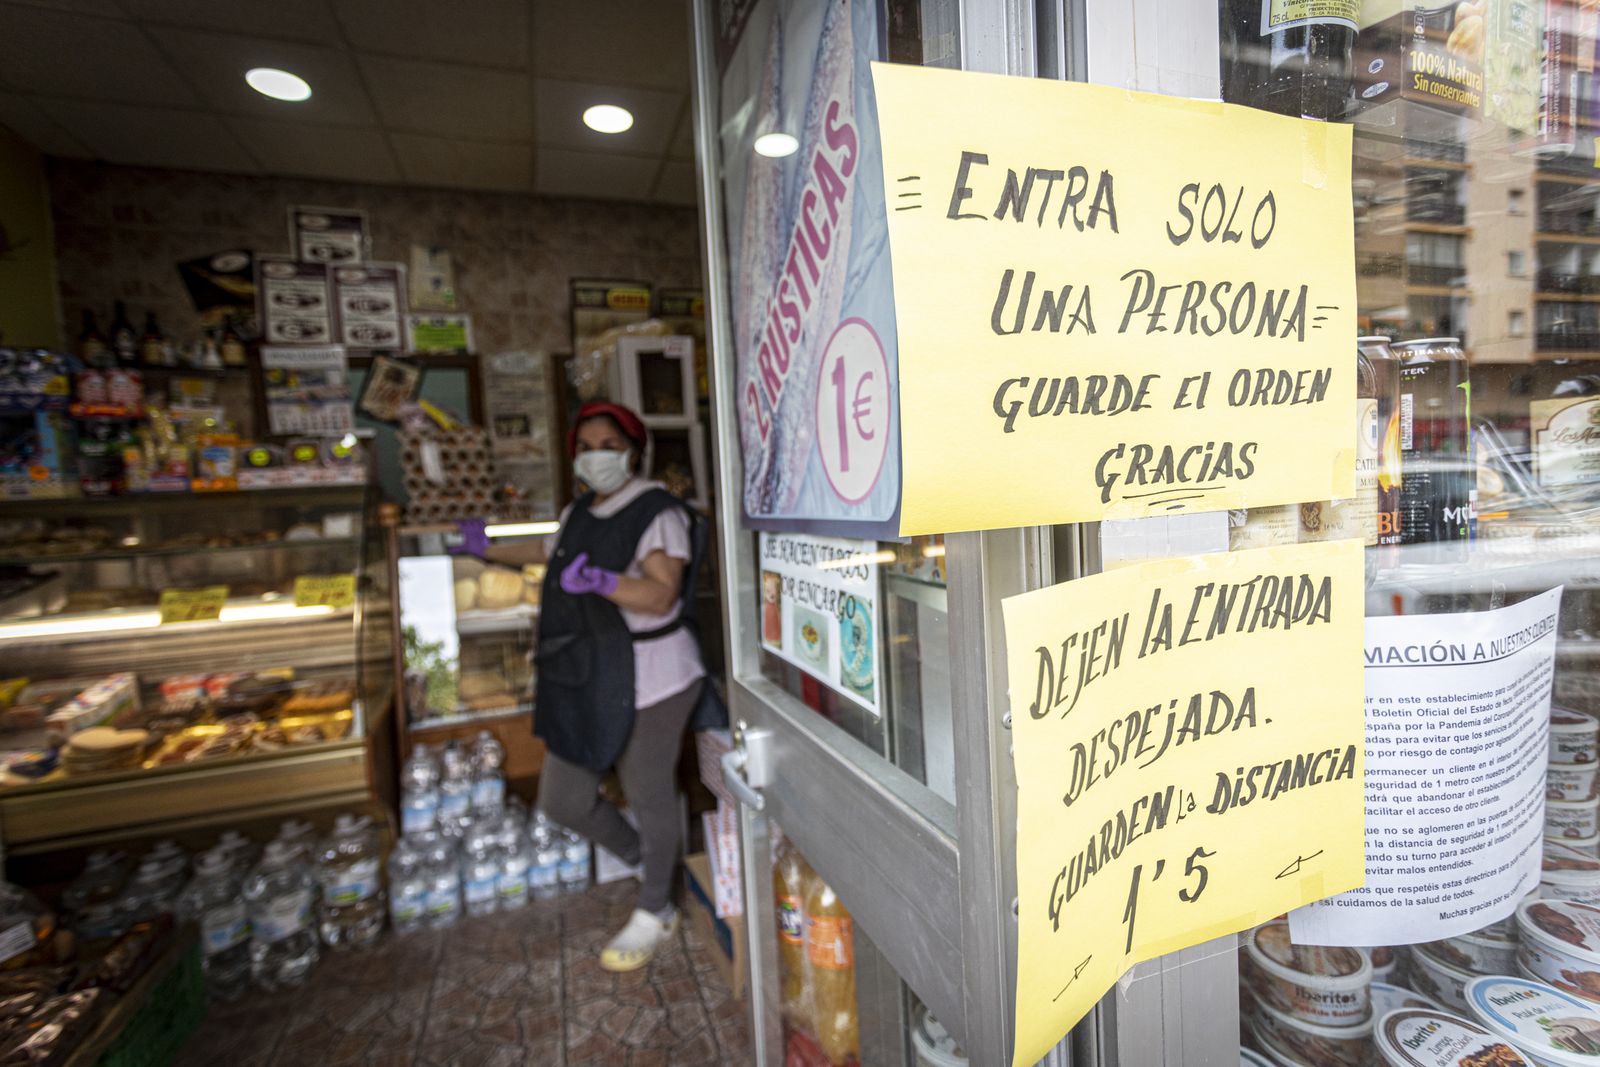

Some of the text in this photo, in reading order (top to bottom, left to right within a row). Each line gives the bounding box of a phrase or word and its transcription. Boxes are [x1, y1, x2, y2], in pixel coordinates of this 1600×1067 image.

[1409, 50, 1484, 92] 100% Natural
[1413, 74, 1429, 92] Sin
[1429, 80, 1480, 108] conservantes
[946, 150, 1277, 249] ENTRA SOLO
[755, 99, 858, 407] RÚSTICAS
[990, 269, 1308, 342] UNA PERSONA
[992, 373, 1160, 434] GUARDE
[1227, 367, 1332, 407] ORDEN
[1177, 573, 1332, 648] ENTRADA
[1473, 642, 1487, 660] A
[1490, 626, 1532, 658] NUESTROS
[1398, 696, 1421, 704] este
[1426, 690, 1493, 704] establecimiento
[1416, 707, 1450, 717] Oficial
[1453, 706, 1468, 716] del
[1470, 703, 1494, 714] Estado
[1395, 737, 1419, 745] para
[1422, 735, 1451, 743] evitar
[1453, 733, 1470, 743] que
[1471, 731, 1483, 740] los
[1484, 724, 1508, 738] servicios
[1404, 723, 1423, 732] por
[1426, 722, 1435, 730] la
[1438, 717, 1481, 729] Pandemia
[1483, 716, 1493, 725] del
[1378, 750, 1396, 758] por
[1400, 748, 1433, 758] riesgo
[1435, 748, 1447, 756] de
[1449, 743, 1484, 755] contagio
[1484, 741, 1495, 751] por
[1364, 769, 1427, 777] permanecer
[1449, 764, 1476, 774] cliente
[1488, 757, 1495, 766] el
[1364, 780, 1417, 791] seguridad
[1420, 781, 1433, 789] de
[1436, 779, 1441, 788] 1
[1444, 777, 1469, 787] metro
[1470, 775, 1484, 784] con
[1485, 767, 1506, 780] nuestro
[1392, 795, 1412, 804] que
[1417, 791, 1465, 802] abandonar
[1468, 788, 1475, 797] el
[1406, 807, 1415, 815] el
[1418, 806, 1451, 815] acceso
[1453, 804, 1463, 812] de
[1464, 801, 1479, 811] otro
[1418, 823, 1464, 836] aglomeren
[1466, 820, 1475, 828] en
[1477, 817, 1486, 825] las
[1374, 839, 1384, 848] la
[1388, 839, 1433, 848] distancia
[1436, 838, 1447, 846] de
[1450, 828, 1485, 844] seguridad
[1486, 827, 1495, 835] de
[1048, 784, 1175, 933] GUARDEN
[1411, 853, 1437, 861] turno
[1439, 849, 1458, 860] para
[1459, 842, 1487, 855] acceder
[1365, 859, 1474, 875] evitar malos entendidos.
[1374, 887, 1394, 896] que
[1397, 882, 1440, 895] respetéis
[1441, 879, 1463, 889] estas
[1464, 869, 1498, 885] directrices
[1337, 898, 1388, 907] cuidamos
[1390, 898, 1403, 907] de
[1405, 898, 1414, 906] la
[1415, 895, 1440, 906] salud
[1441, 893, 1452, 902] de
[1453, 888, 1475, 900] todos.
[1439, 908, 1469, 920] Muchas
[1469, 899, 1493, 914] gracias
[1492, 895, 1504, 907] por
[1489, 989, 1541, 1007] Iberitos
[1402, 1020, 1443, 1050] Iberitos
